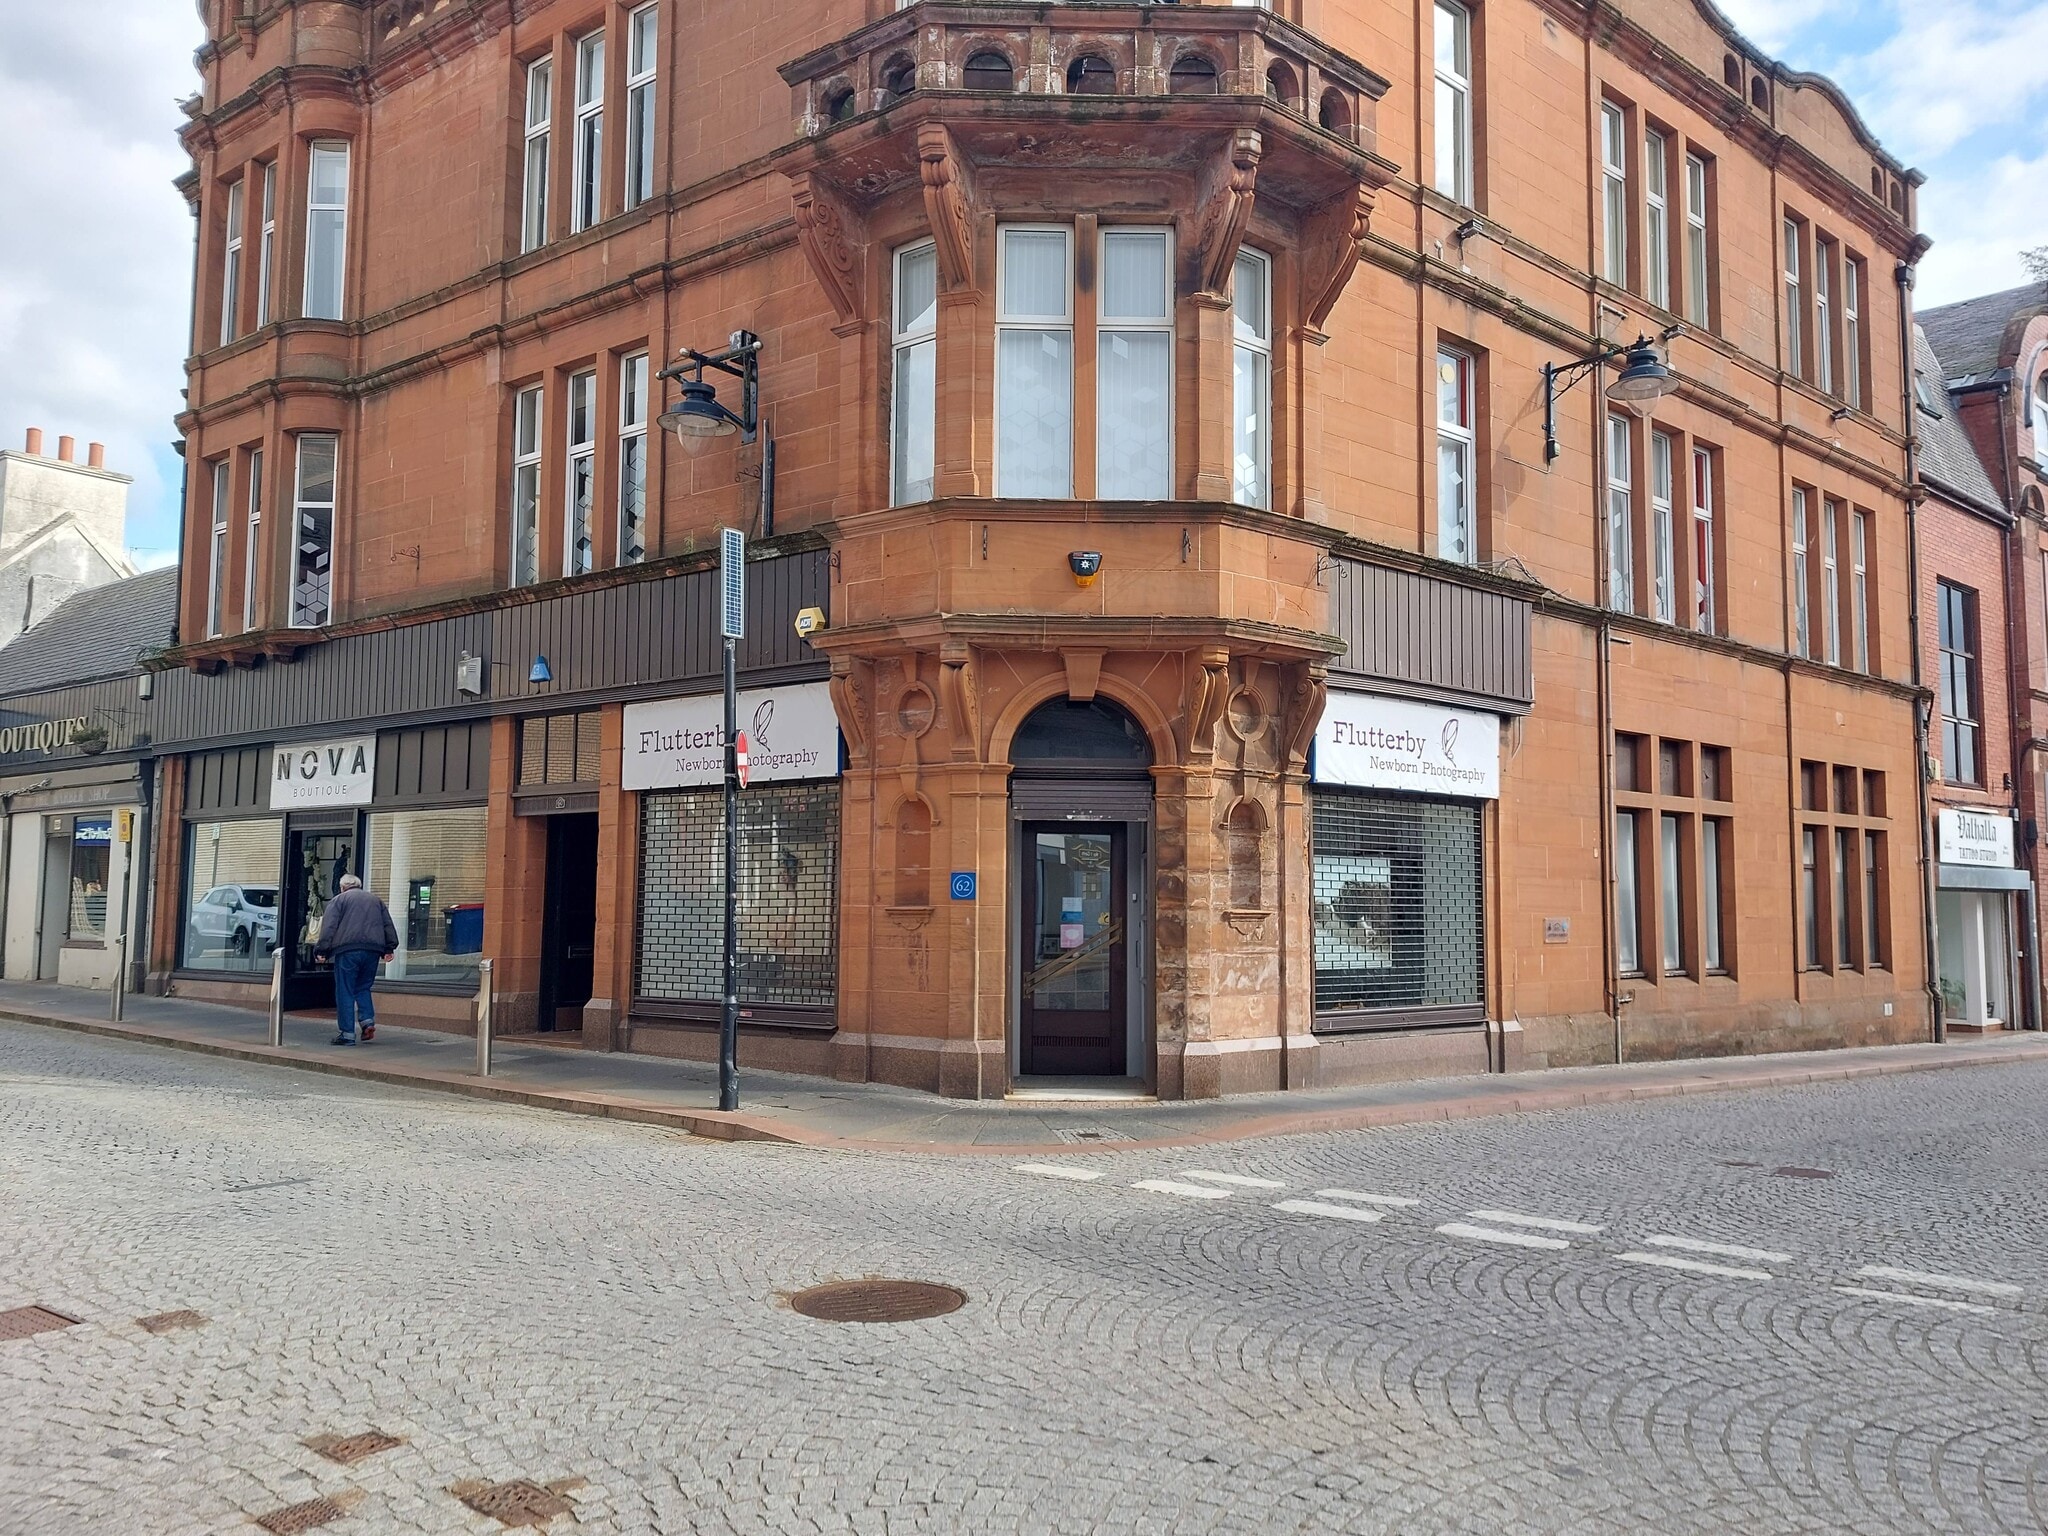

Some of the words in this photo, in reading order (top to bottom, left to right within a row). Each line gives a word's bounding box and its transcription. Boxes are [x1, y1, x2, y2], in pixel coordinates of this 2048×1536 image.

[639, 724, 726, 754] Flutterb
[1333, 721, 1426, 759] Flutterby
[277, 745, 366, 781] NOVA
[1370, 755, 1418, 774] Newborn
[1422, 762, 1486, 784] Photography
[293, 784, 347, 798] BOUTIQUE
[1957, 814, 1997, 844] Valhalla
[956, 879, 970, 892] 62
